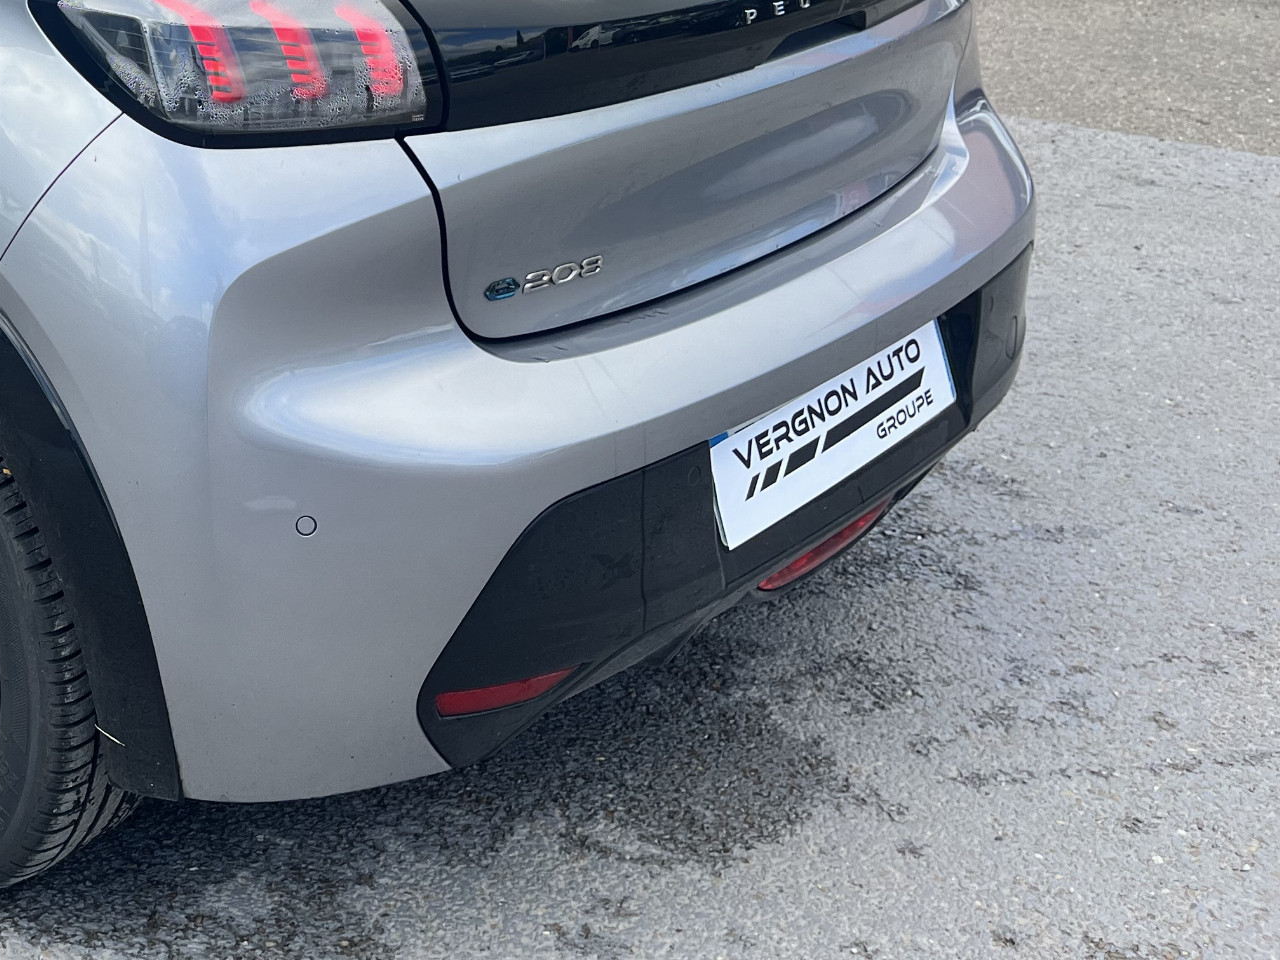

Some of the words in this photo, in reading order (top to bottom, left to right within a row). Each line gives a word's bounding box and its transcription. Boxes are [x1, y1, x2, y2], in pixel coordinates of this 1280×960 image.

[732, 377, 858, 469] VERGNON
[865, 338, 921, 395] AUTO
[875, 388, 934, 440] GROUPE
